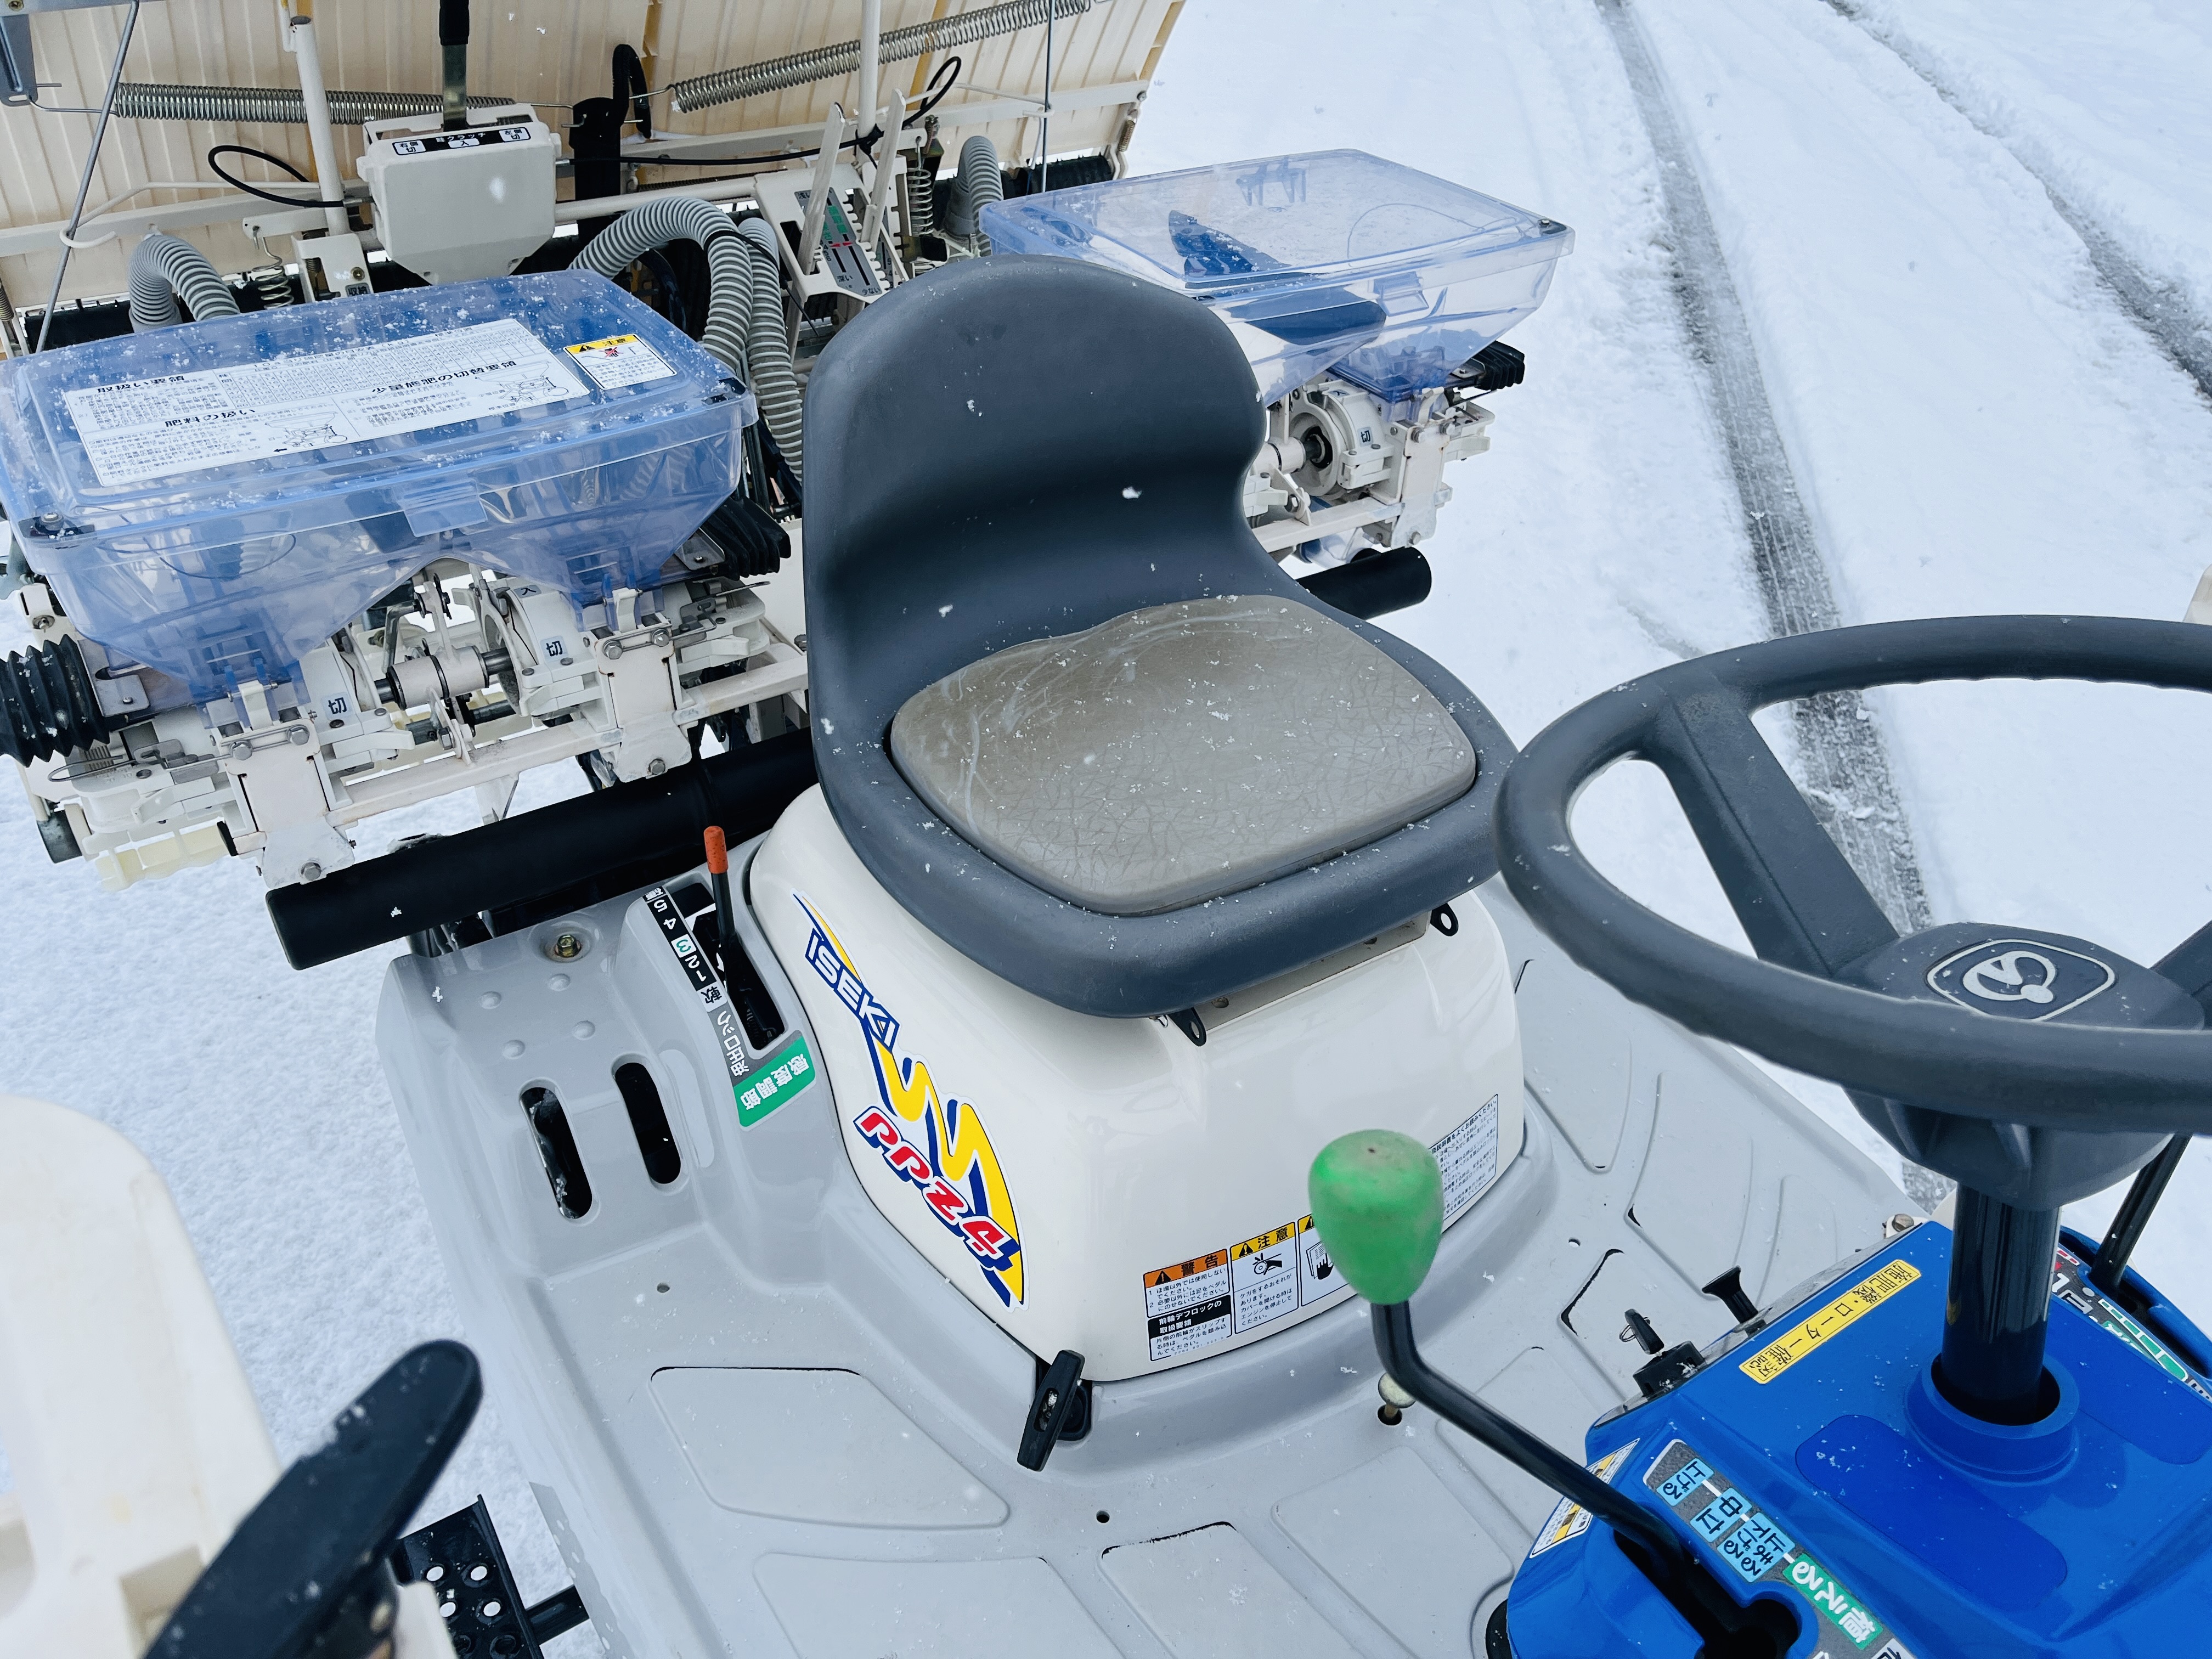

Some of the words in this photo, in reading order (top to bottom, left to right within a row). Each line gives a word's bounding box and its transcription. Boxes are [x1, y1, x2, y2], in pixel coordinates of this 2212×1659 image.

[97, 376, 185, 393] 取扱い要領
[373, 361, 517, 394] 少量施肥の切替要領
[165, 409, 256, 427] 肥料の扱い
[1361, 430, 1371, 443] 切
[521, 587, 537, 596] 入
[546, 640, 563, 657] 切
[328, 697, 347, 714] 切
[653, 899, 668, 912] 5
[663, 917, 676, 930] 4
[676, 939, 691, 952] 3
[685, 955, 699, 969] 2
[696, 970, 707, 982] 1
[701, 986, 723, 1004] 軟
[808, 934, 896, 1047] ISEKI
[717, 1010, 749, 1076] 油圧ロック
[740, 1053, 810, 1110] 感度調節
[858, 1110, 1007, 1257] PPZ4
[1257, 1227, 1288, 1250] 注意
[1181, 1255, 1218, 1277] 警告
[1240, 1273, 1292, 1300] ケガをするおそれが
[1240, 1293, 1267, 1306] あります。
[1241, 1288, 1292, 1313] カバーを開ける時は
[1241, 1295, 1293, 1320] エンジンを停止して
[1159, 1300, 1222, 1325] 前輪デフロックの
[1242, 1313, 1268, 1326] ください。
[1749, 1263, 1914, 1377] 施肥機・ローター確認
[1160, 1319, 1192, 1334] 取扱要領
[1663, 1460, 1706, 1500] 上げる
[1695, 1496, 1743, 1534] 中立
[1724, 1519, 1771, 1559] 下げる
[1741, 1532, 1786, 1576] 止まる
[1792, 1561, 1876, 1644] 植える
